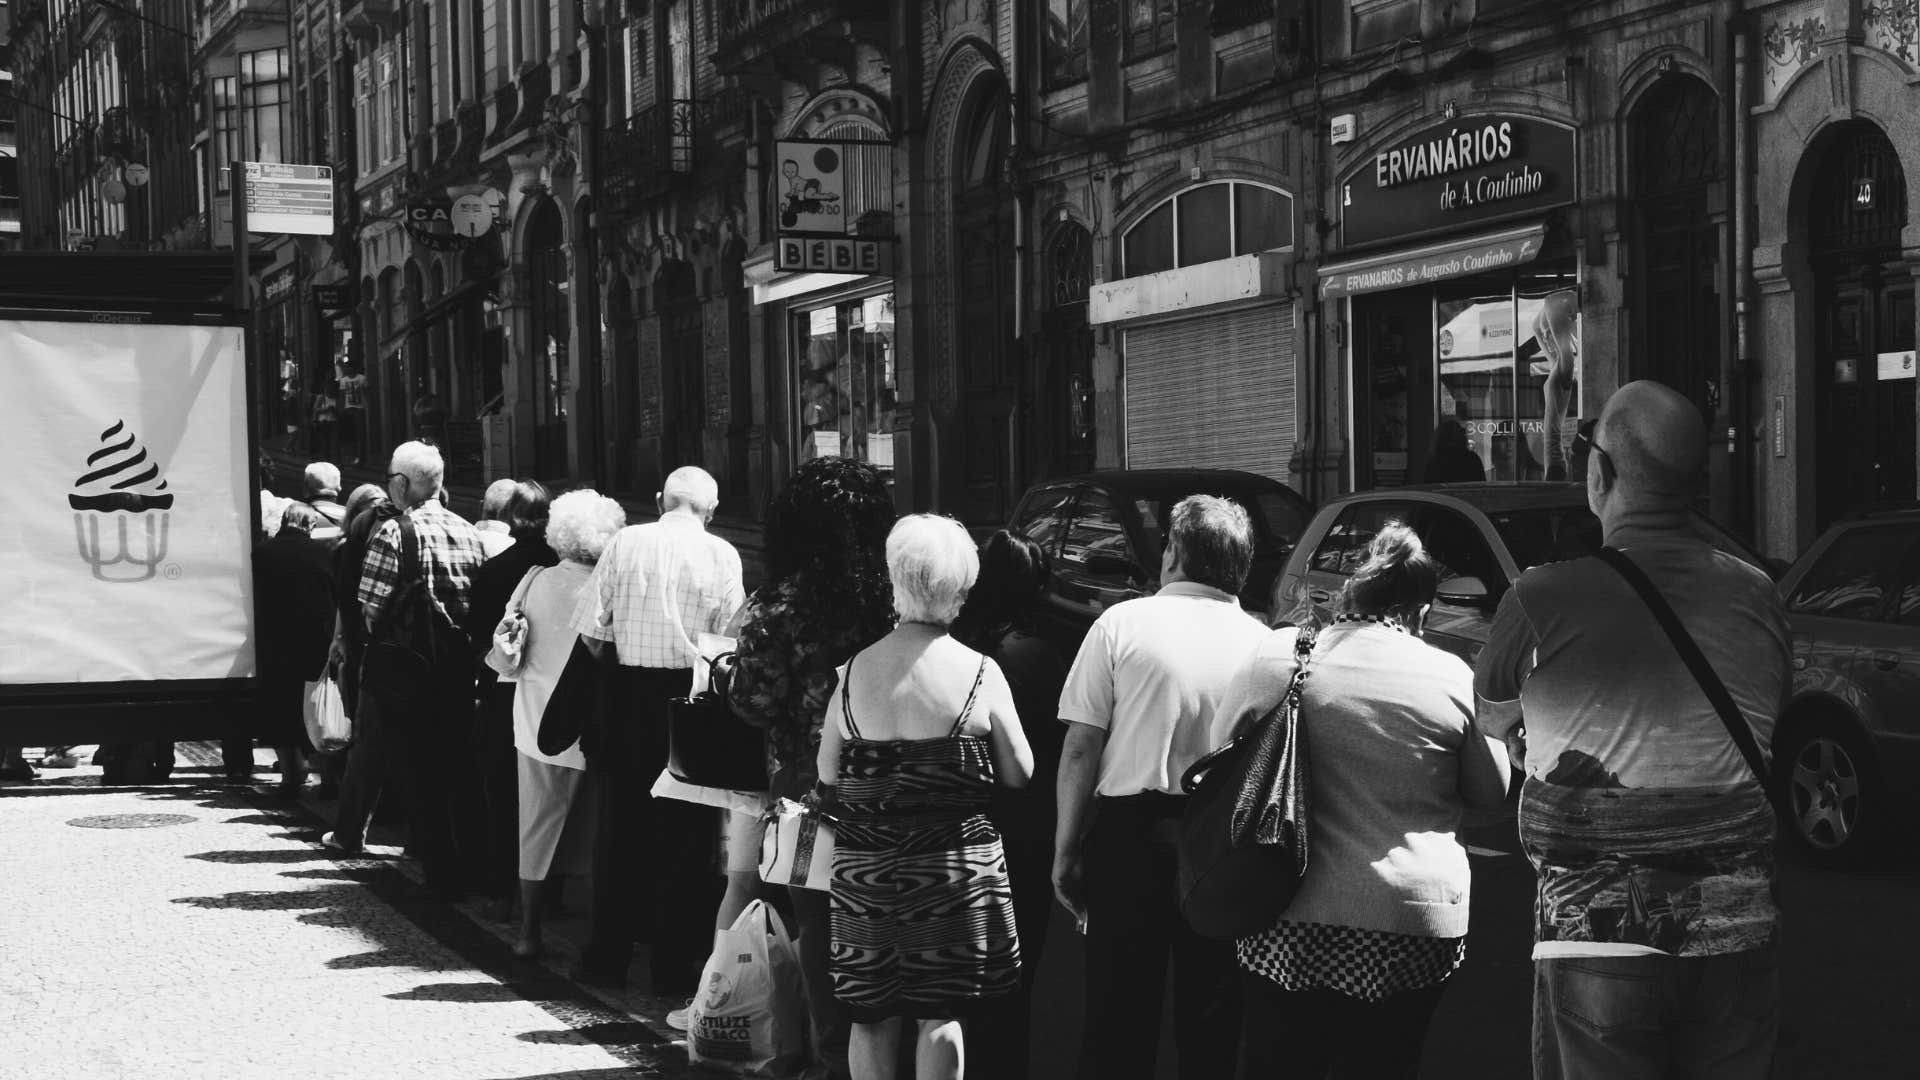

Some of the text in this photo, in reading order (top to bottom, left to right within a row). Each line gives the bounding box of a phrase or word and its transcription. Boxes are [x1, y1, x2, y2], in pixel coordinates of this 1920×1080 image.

[1376, 121, 1511, 188] ERVANÁRIOS
[1440, 165, 1542, 211] de A. Coutinho
[1857, 184, 1871, 204] 40
[1346, 249, 1513, 291] ERVANARIOS de Augusto Coutinho
[1477, 421, 1545, 434] COLLITAR
[698, 1014, 751, 1028] UTILIZE
